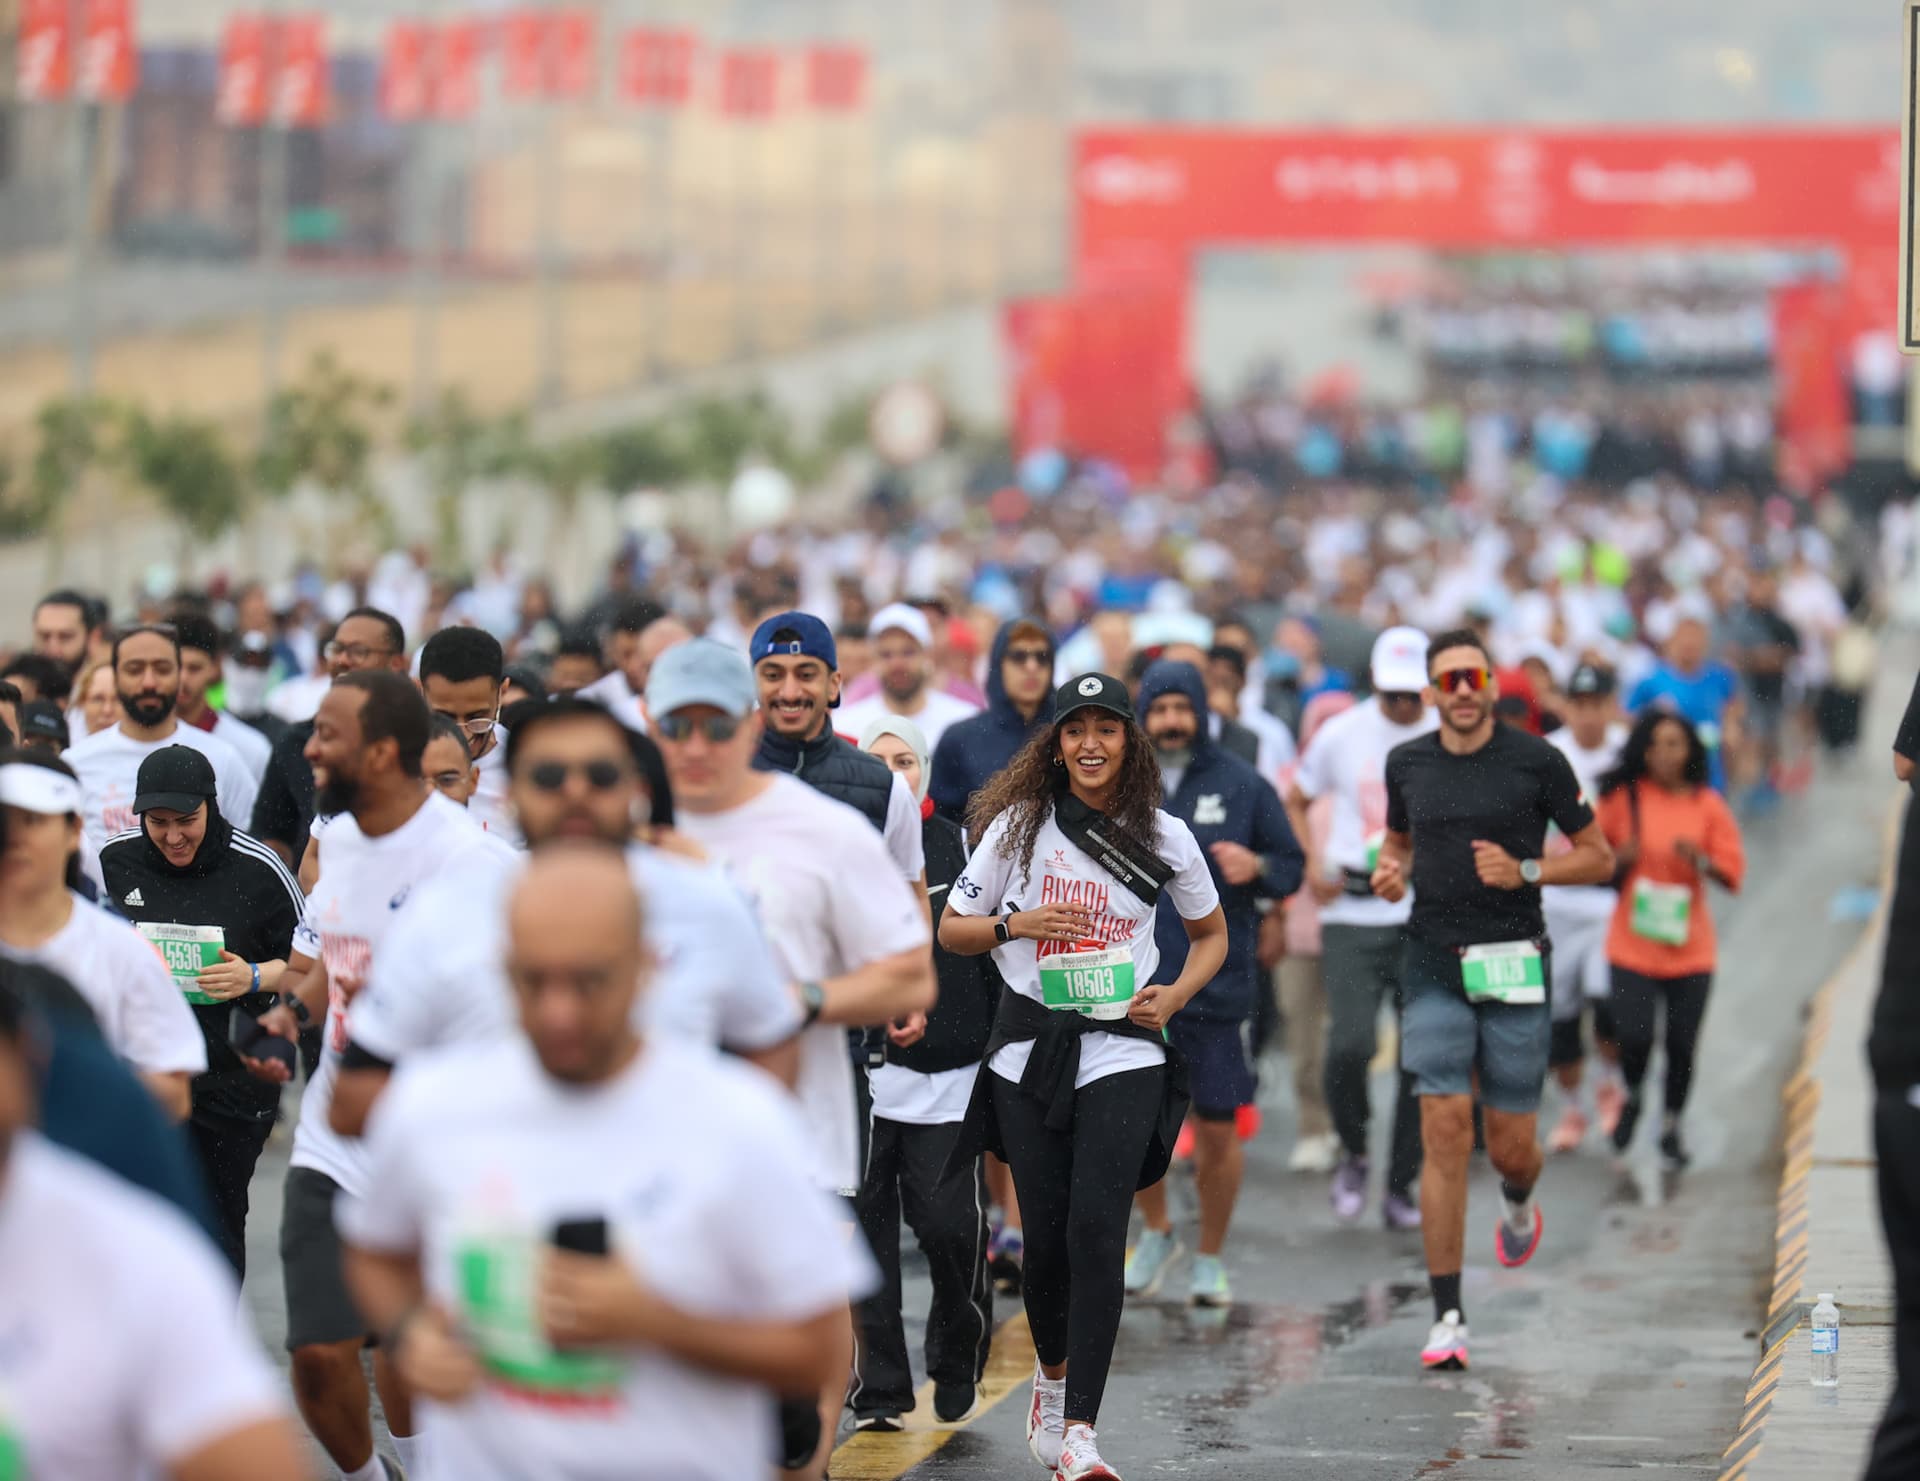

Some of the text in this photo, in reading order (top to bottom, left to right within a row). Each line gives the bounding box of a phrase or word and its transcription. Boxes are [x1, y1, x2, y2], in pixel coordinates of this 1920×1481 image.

[1042, 874, 1109, 913] RIYADH
[157, 941, 202, 971] 15536
[1063, 967, 1115, 999] 18503
